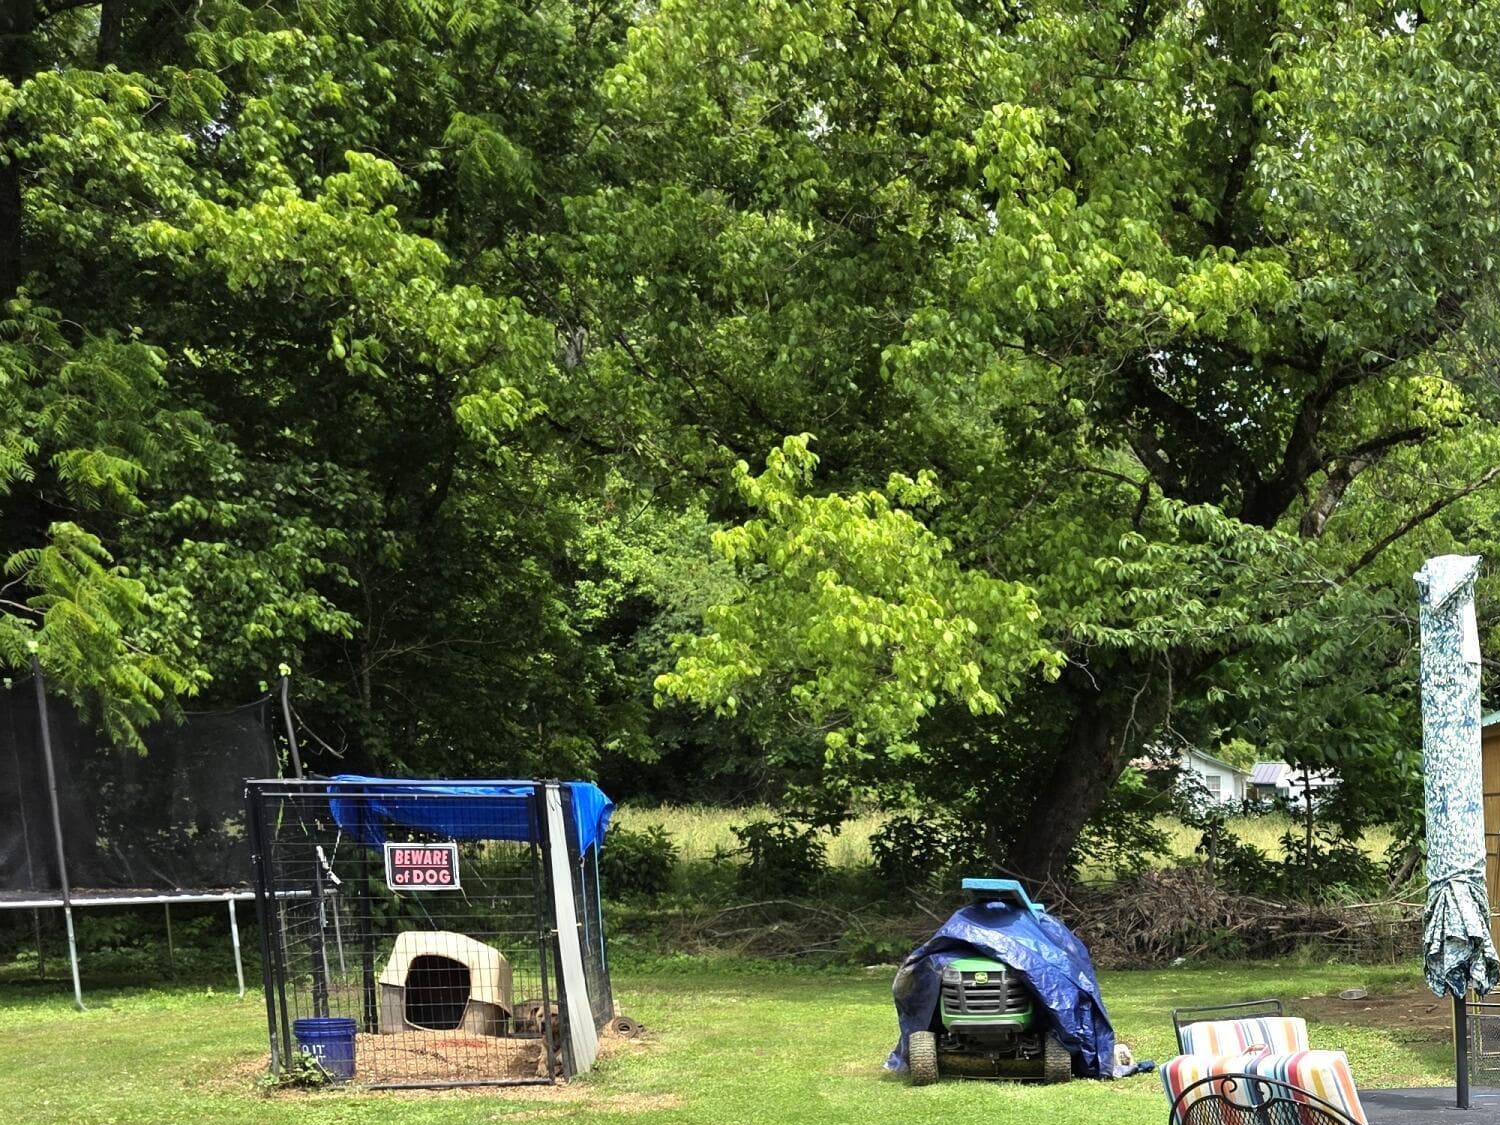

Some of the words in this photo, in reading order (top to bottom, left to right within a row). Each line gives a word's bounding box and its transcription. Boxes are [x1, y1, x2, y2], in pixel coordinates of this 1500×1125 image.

[394, 849, 449, 865] BEWARE
[395, 870, 410, 884] of
[412, 869, 451, 884] DOG
